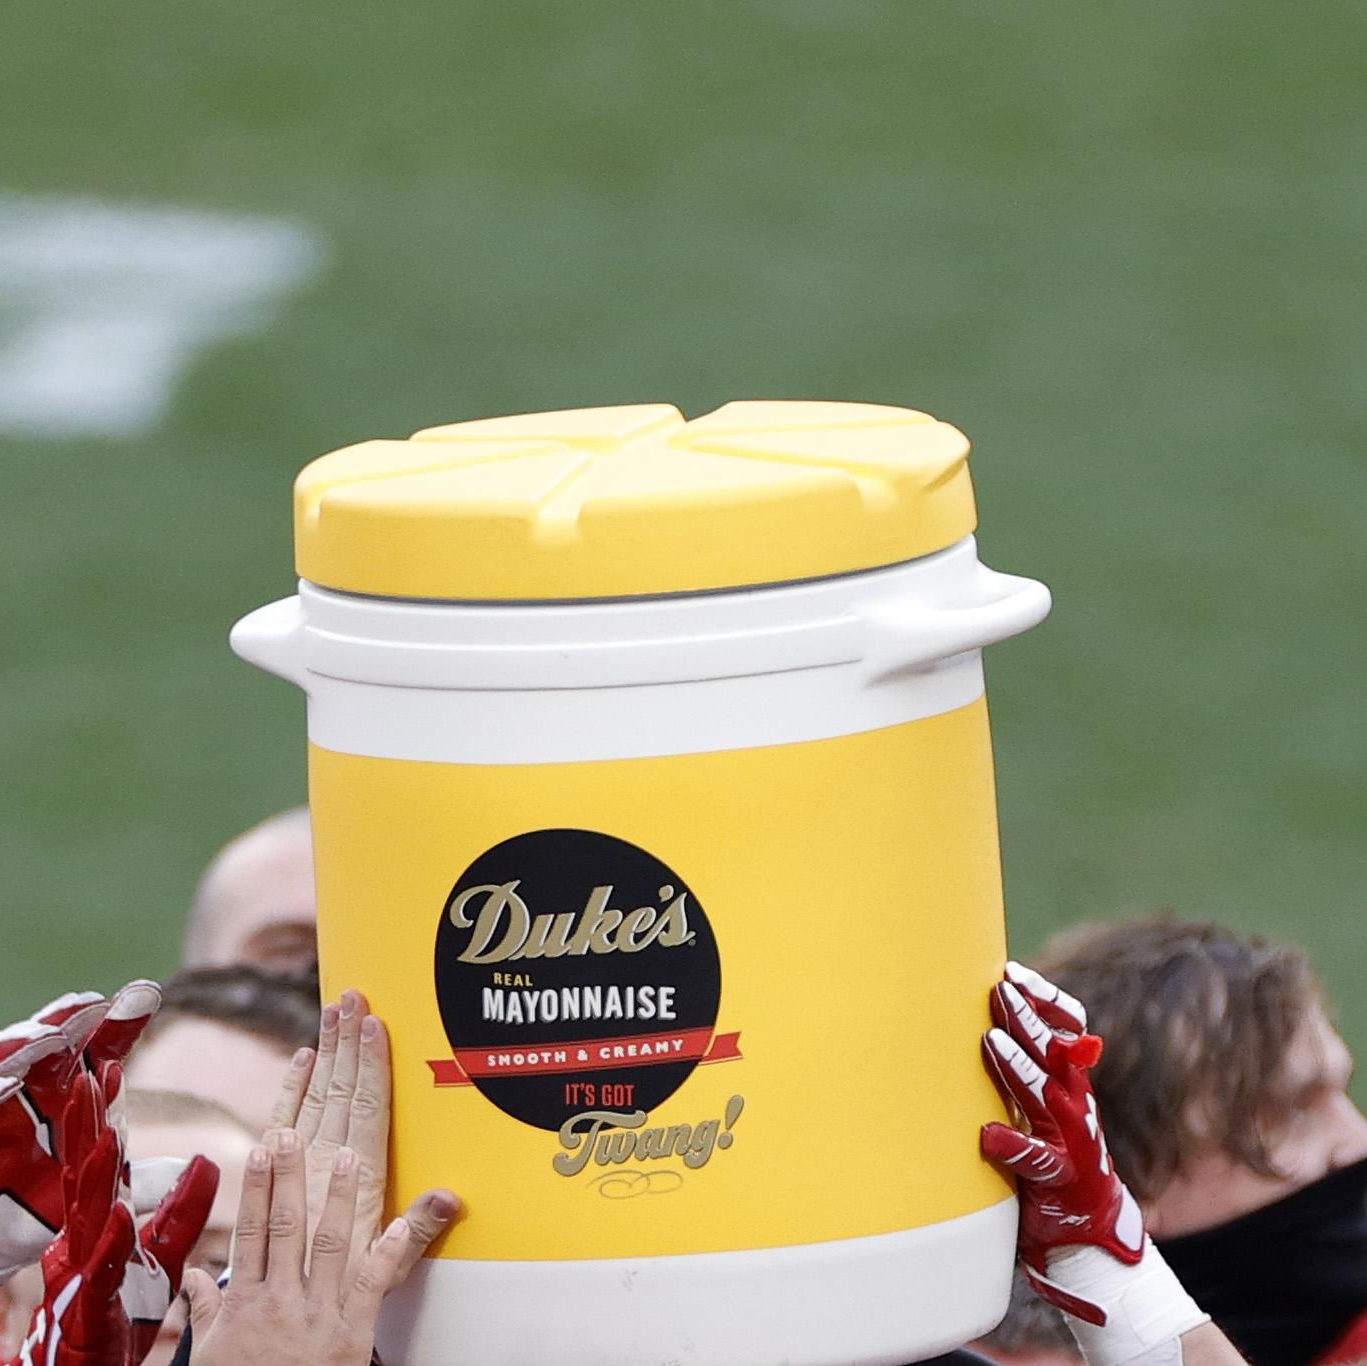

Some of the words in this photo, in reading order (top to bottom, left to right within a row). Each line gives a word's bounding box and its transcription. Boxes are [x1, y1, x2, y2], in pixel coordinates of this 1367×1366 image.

[449, 880, 695, 964] Duke's
[494, 972, 533, 987] REAL
[483, 986, 677, 1025] MAYONNAISE
[487, 1049, 567, 1067] SMOOTH
[577, 1047, 588, 1062] &
[599, 1039, 684, 1060] CREAMY
[565, 1083, 595, 1106] IT'S
[601, 1083, 636, 1107] GOT
[553, 1094, 745, 1177] Twang!
